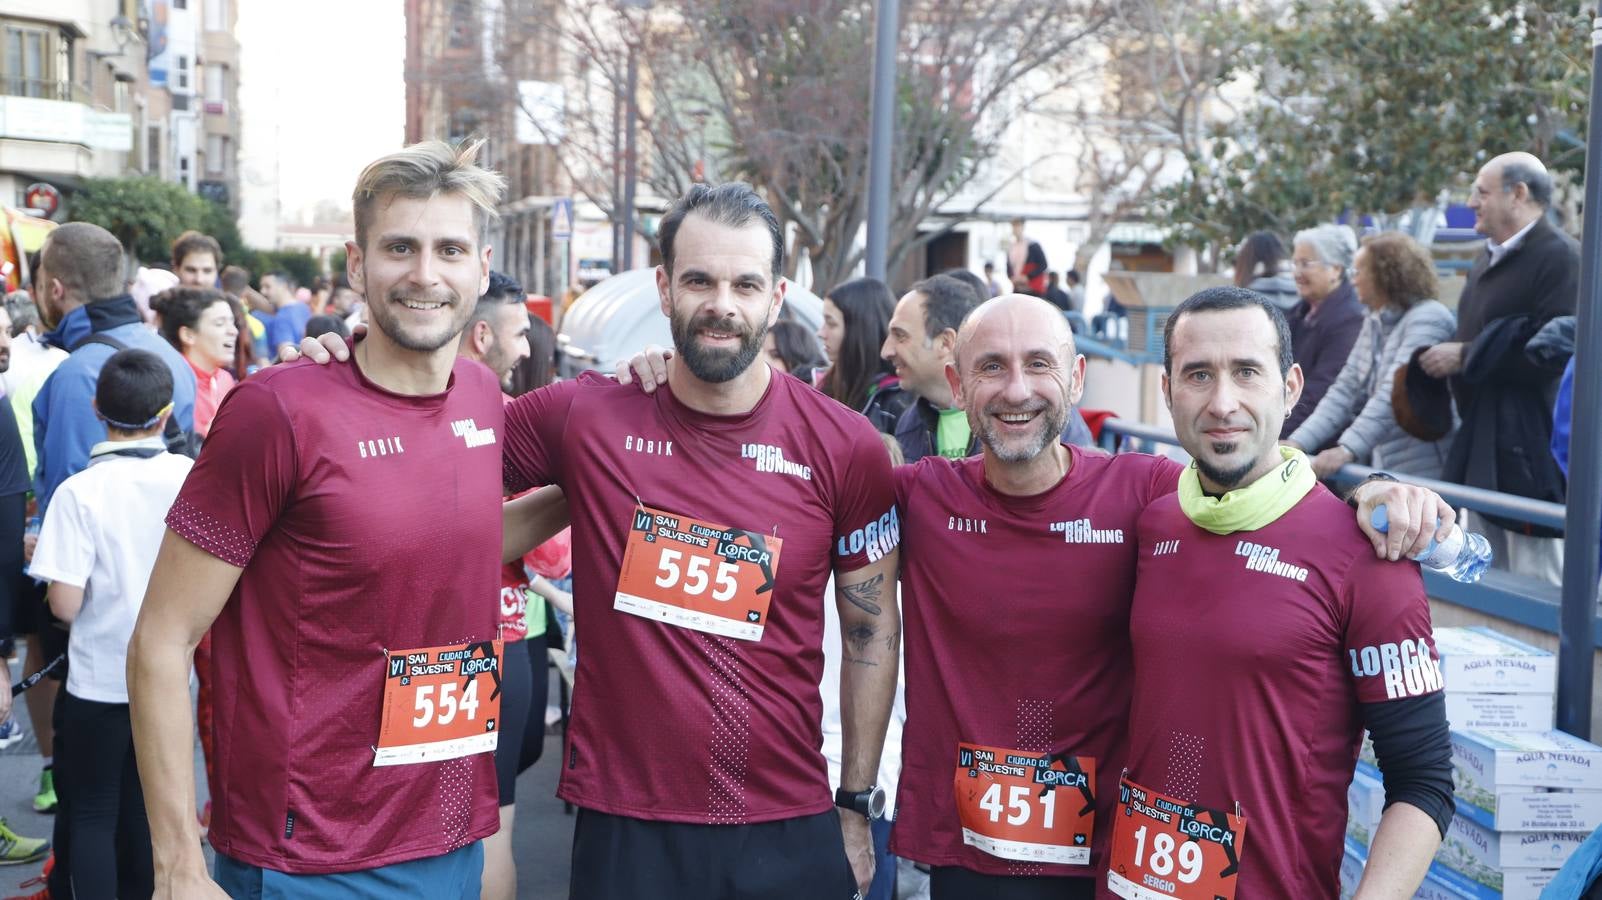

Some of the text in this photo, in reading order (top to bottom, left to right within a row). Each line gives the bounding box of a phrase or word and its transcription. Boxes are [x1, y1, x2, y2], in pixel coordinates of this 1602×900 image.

[358, 436, 404, 459] GOBIK
[625, 435, 673, 456] GOBIK
[741, 443, 783, 460] LORCA
[756, 455, 812, 481] RUNNING
[637, 513, 678, 530] VI SAN
[838, 504, 900, 556] LORCA
[948, 516, 987, 534] GOBIK
[1050, 518, 1092, 532] LORCA
[657, 527, 709, 547] SILVESTRE
[691, 525, 734, 541] CIUDAD DE
[1065, 528, 1124, 544] RUNNING
[717, 542, 770, 566] LORCA
[1234, 540, 1280, 562] LORCA
[655, 548, 740, 602] 555
[1245, 555, 1309, 582] RUNNING
[408, 653, 428, 665] SAN
[439, 649, 472, 661] CIUDAD DE
[1349, 637, 1431, 677] LORCA
[411, 663, 454, 676] SILVESTRE
[461, 658, 498, 676] LORCA
[1463, 658, 1536, 672] AQUA NEVADA
[413, 679, 479, 728] 554
[961, 751, 994, 766] VI SAN
[1007, 755, 1050, 767] CIUDAD DE
[1516, 752, 1591, 768] AQUA NEVADA
[978, 762, 1025, 776] SILVESTRE
[1035, 770, 1087, 787] LORCA
[1121, 786, 1147, 802] VI SAN
[979, 783, 1056, 829] 451
[1133, 801, 1171, 823] SILVESTRE
[1156, 799, 1195, 817] CIUDAD DE
[1179, 819, 1233, 846] LORCA
[1521, 832, 1586, 845] AQUA NEVAD
[1134, 825, 1203, 884] 189
[1142, 873, 1176, 893] SERGIO
